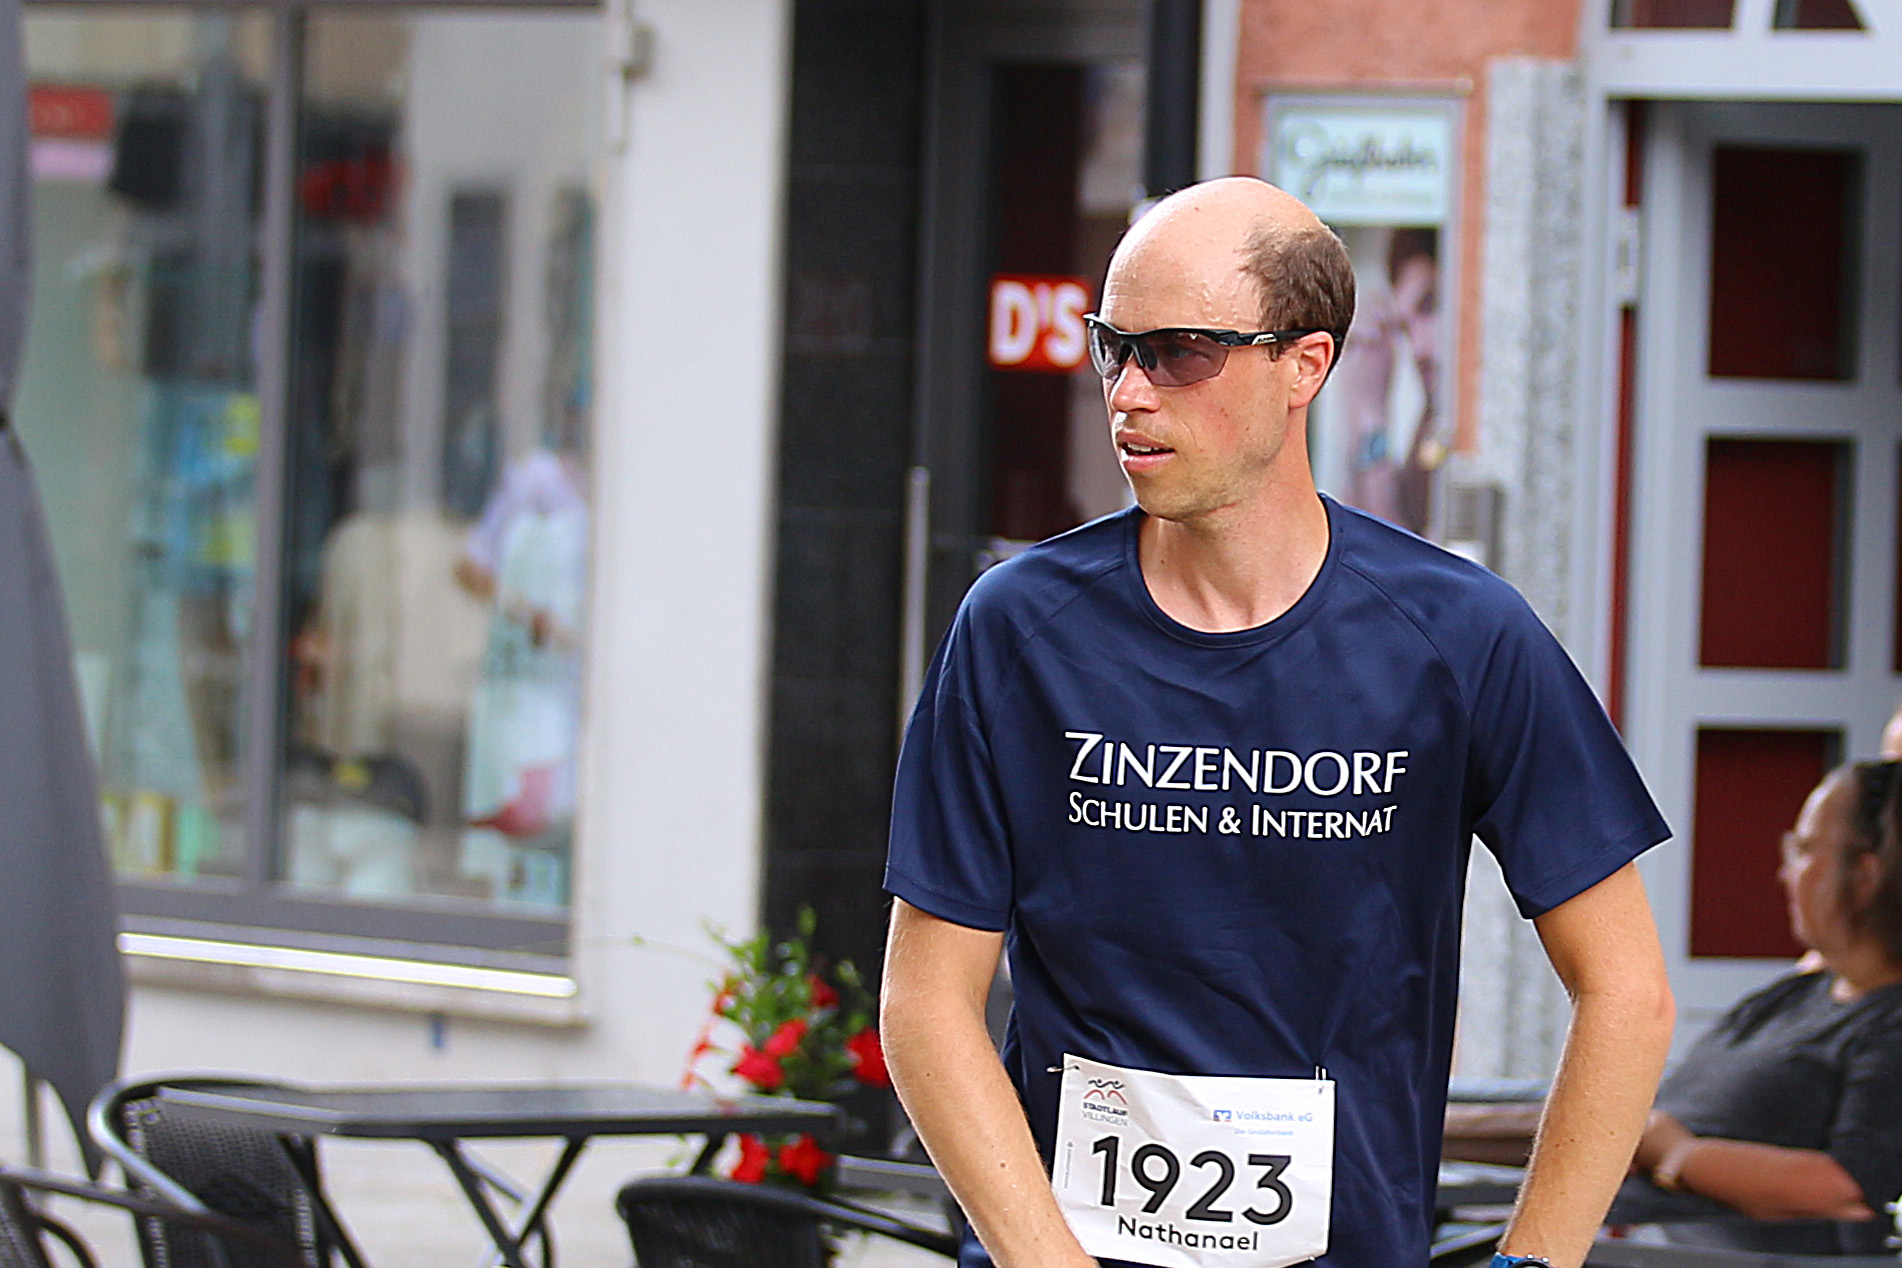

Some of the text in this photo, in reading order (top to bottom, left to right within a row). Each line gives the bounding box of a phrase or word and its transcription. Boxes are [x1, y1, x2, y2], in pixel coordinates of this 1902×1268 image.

[990, 280, 1088, 367] D'S
[1065, 731, 1409, 796] ZINZENDORF
[1069, 791, 1397, 839] SCHULEN & INTERNAT
[1082, 1111, 1127, 1126] VILLINGEN
[1236, 1110, 1313, 1122] Volksbank eG
[1092, 1135, 1293, 1225] 1923
[1118, 1215, 1258, 1250] Nathanael
